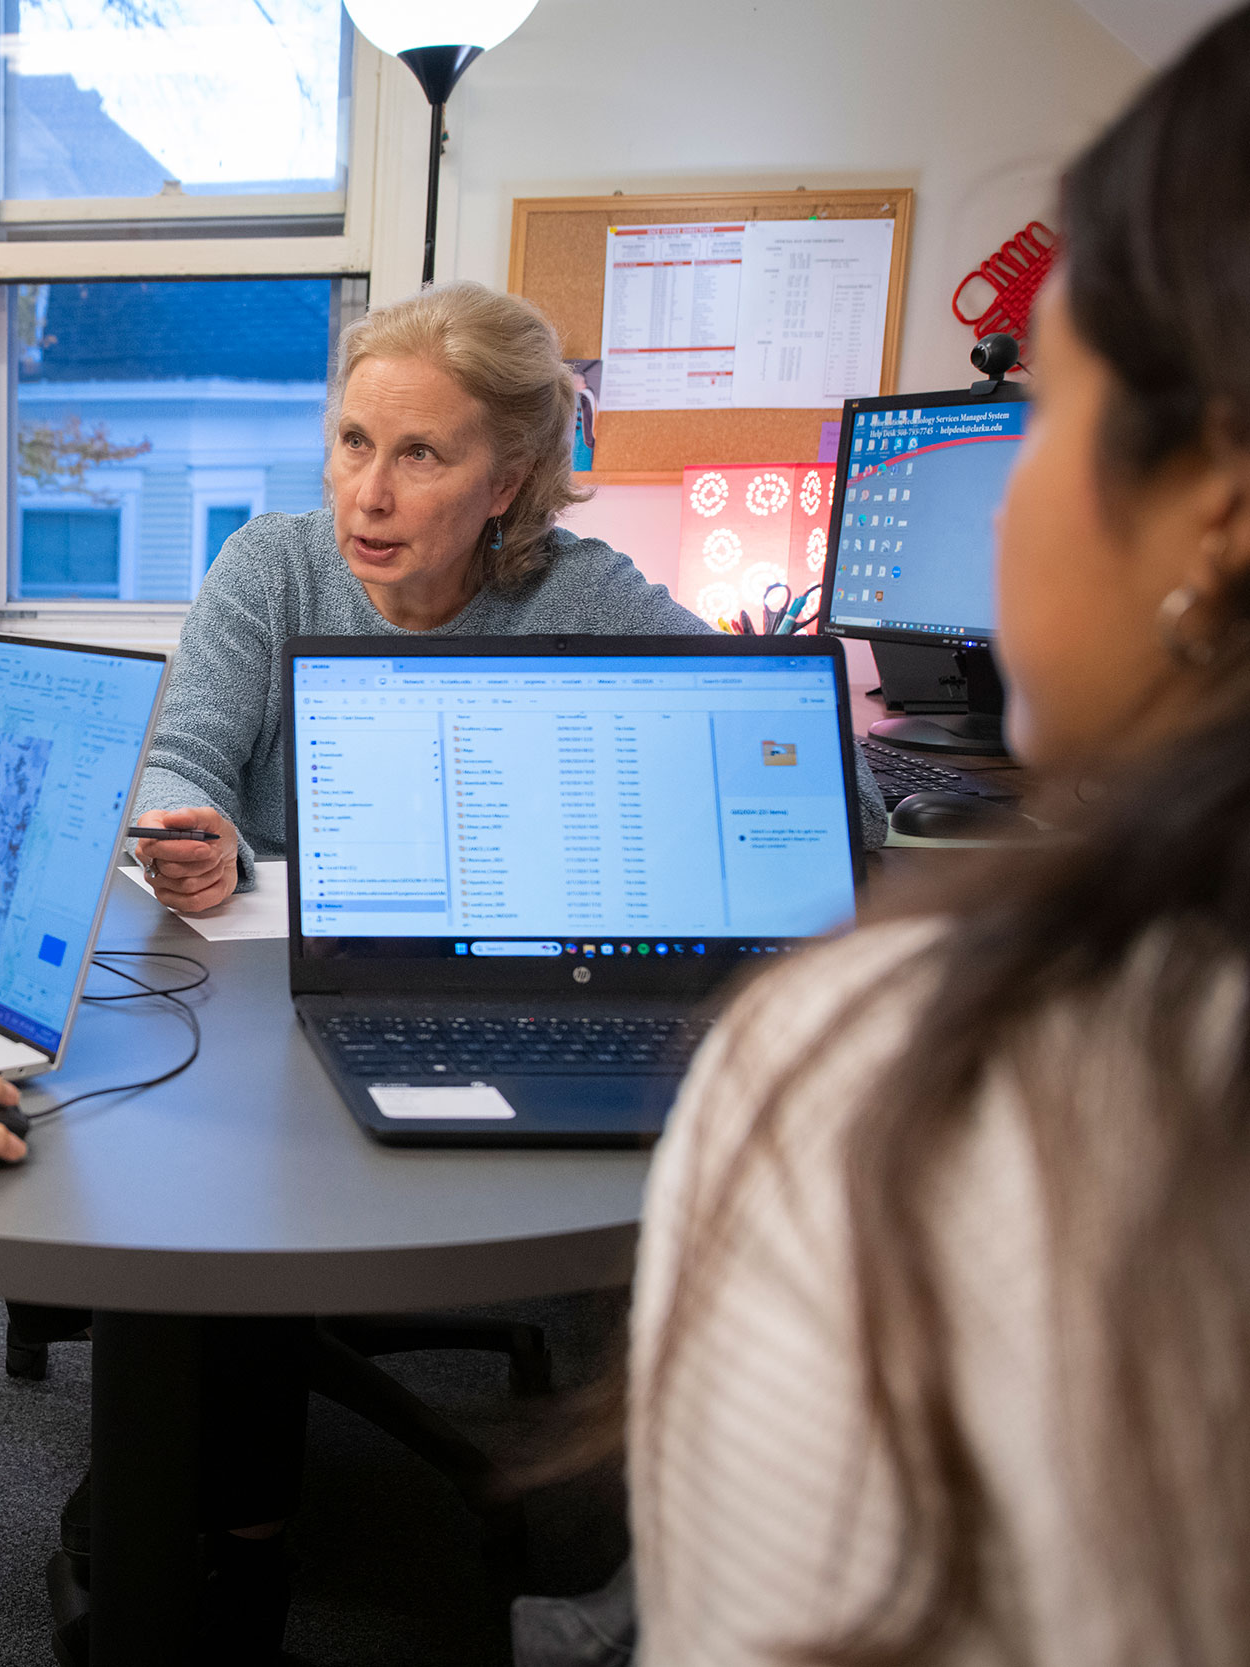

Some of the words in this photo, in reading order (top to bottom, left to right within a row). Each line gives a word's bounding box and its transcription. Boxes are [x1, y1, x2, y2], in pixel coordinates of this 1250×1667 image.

[936, 414, 959, 424] Services
[960, 412, 988, 423] Managed
[988, 411, 1010, 421] System
[870, 429, 882, 439] Help
[883, 428, 896, 437] Desk
[940, 423, 1002, 436] helpdesk@clarku.edu
[824, 626, 846, 635] ViewSonic
